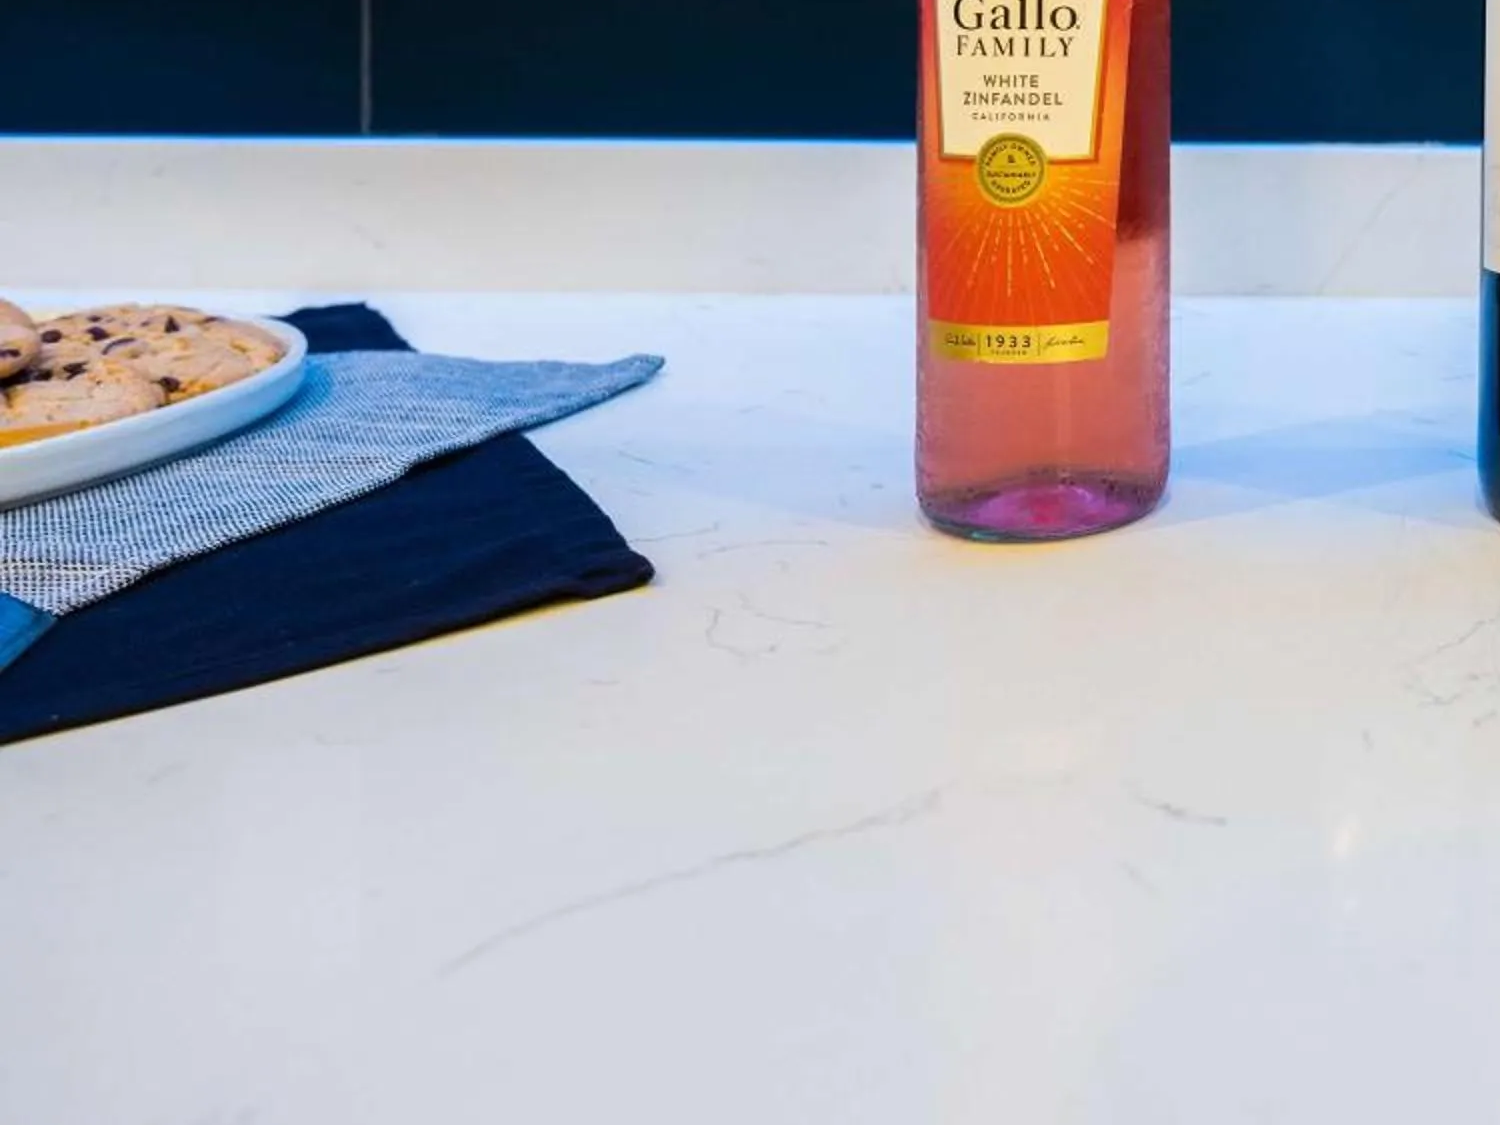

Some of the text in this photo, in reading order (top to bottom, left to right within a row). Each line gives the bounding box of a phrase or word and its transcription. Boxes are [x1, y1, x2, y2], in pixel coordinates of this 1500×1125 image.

[956, 35, 1074, 57] FAMILY
[983, 74, 1039, 88] WHITE
[963, 92, 1063, 106] ZINFANDEL
[972, 112, 1050, 121] CALIFORNIA
[986, 334, 1031, 348] 1933
